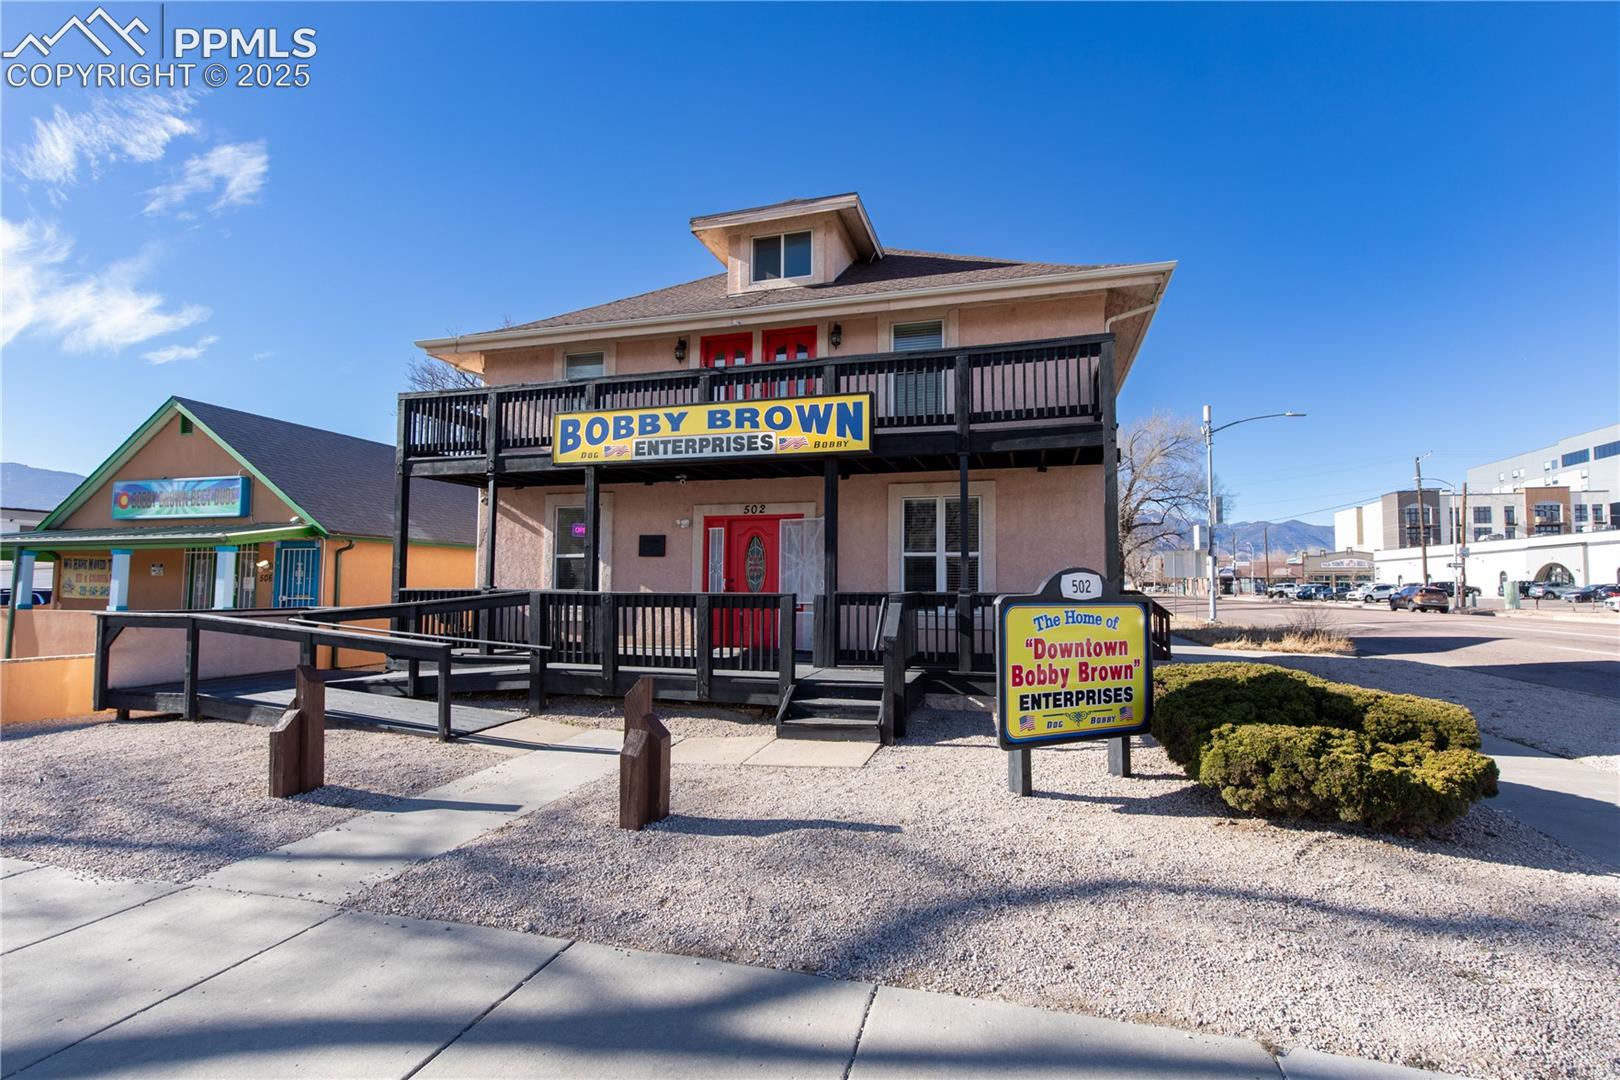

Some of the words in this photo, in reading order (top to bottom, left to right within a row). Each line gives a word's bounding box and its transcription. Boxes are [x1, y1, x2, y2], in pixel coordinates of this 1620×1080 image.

[559, 411, 688, 455] BOBBY
[707, 401, 864, 441] BROWN
[634, 434, 774, 457] ENTERPRISES
[743, 504, 766, 515] 502
[1072, 580, 1091, 593] 502
[1034, 614, 1060, 632] The
[1064, 609, 1102, 626] Home
[1106, 616, 1119, 630] of
[1011, 663, 1069, 688] Bobby
[1019, 687, 1133, 711] ENTERPRISES
